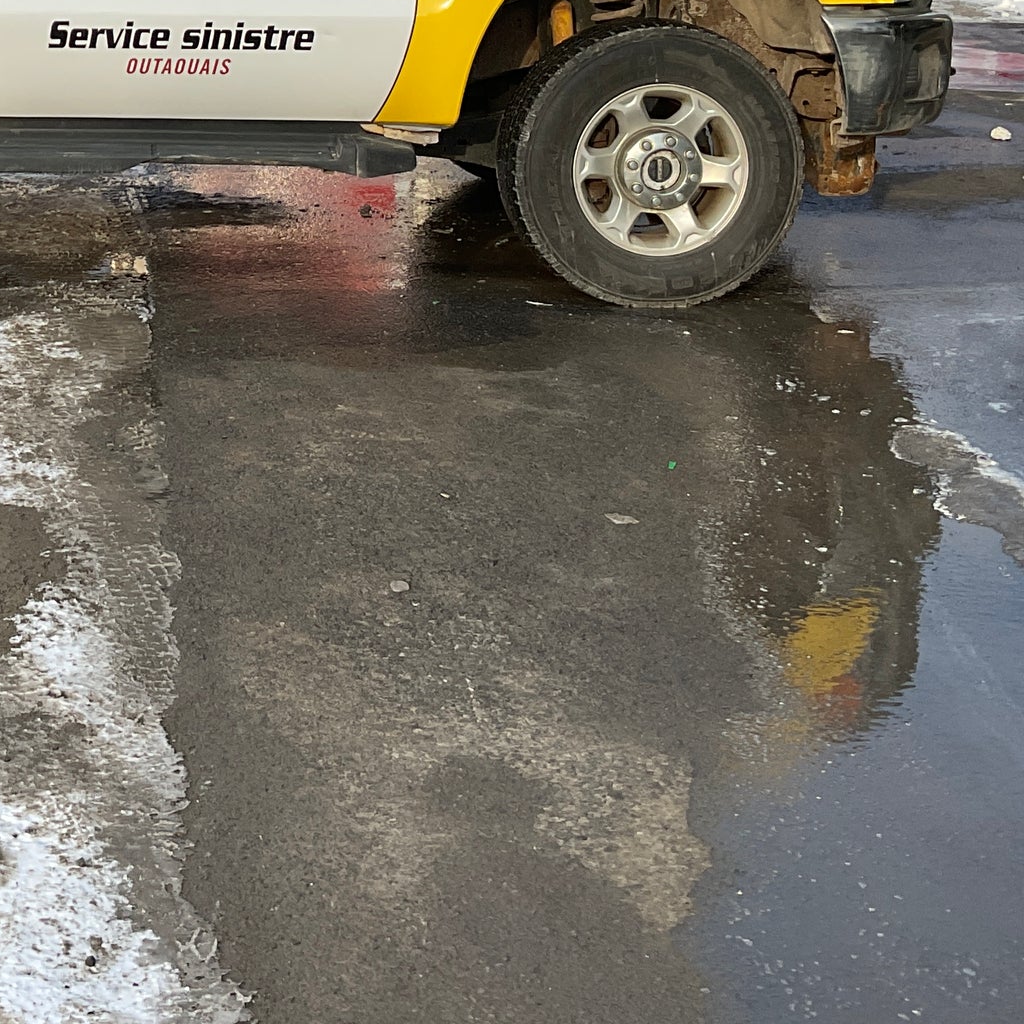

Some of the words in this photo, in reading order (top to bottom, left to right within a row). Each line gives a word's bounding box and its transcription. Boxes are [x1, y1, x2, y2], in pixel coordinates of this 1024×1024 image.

[48, 20, 171, 49] Service
[181, 22, 315, 51] sinistre
[126, 57, 232, 75] OUTAOUAIS
